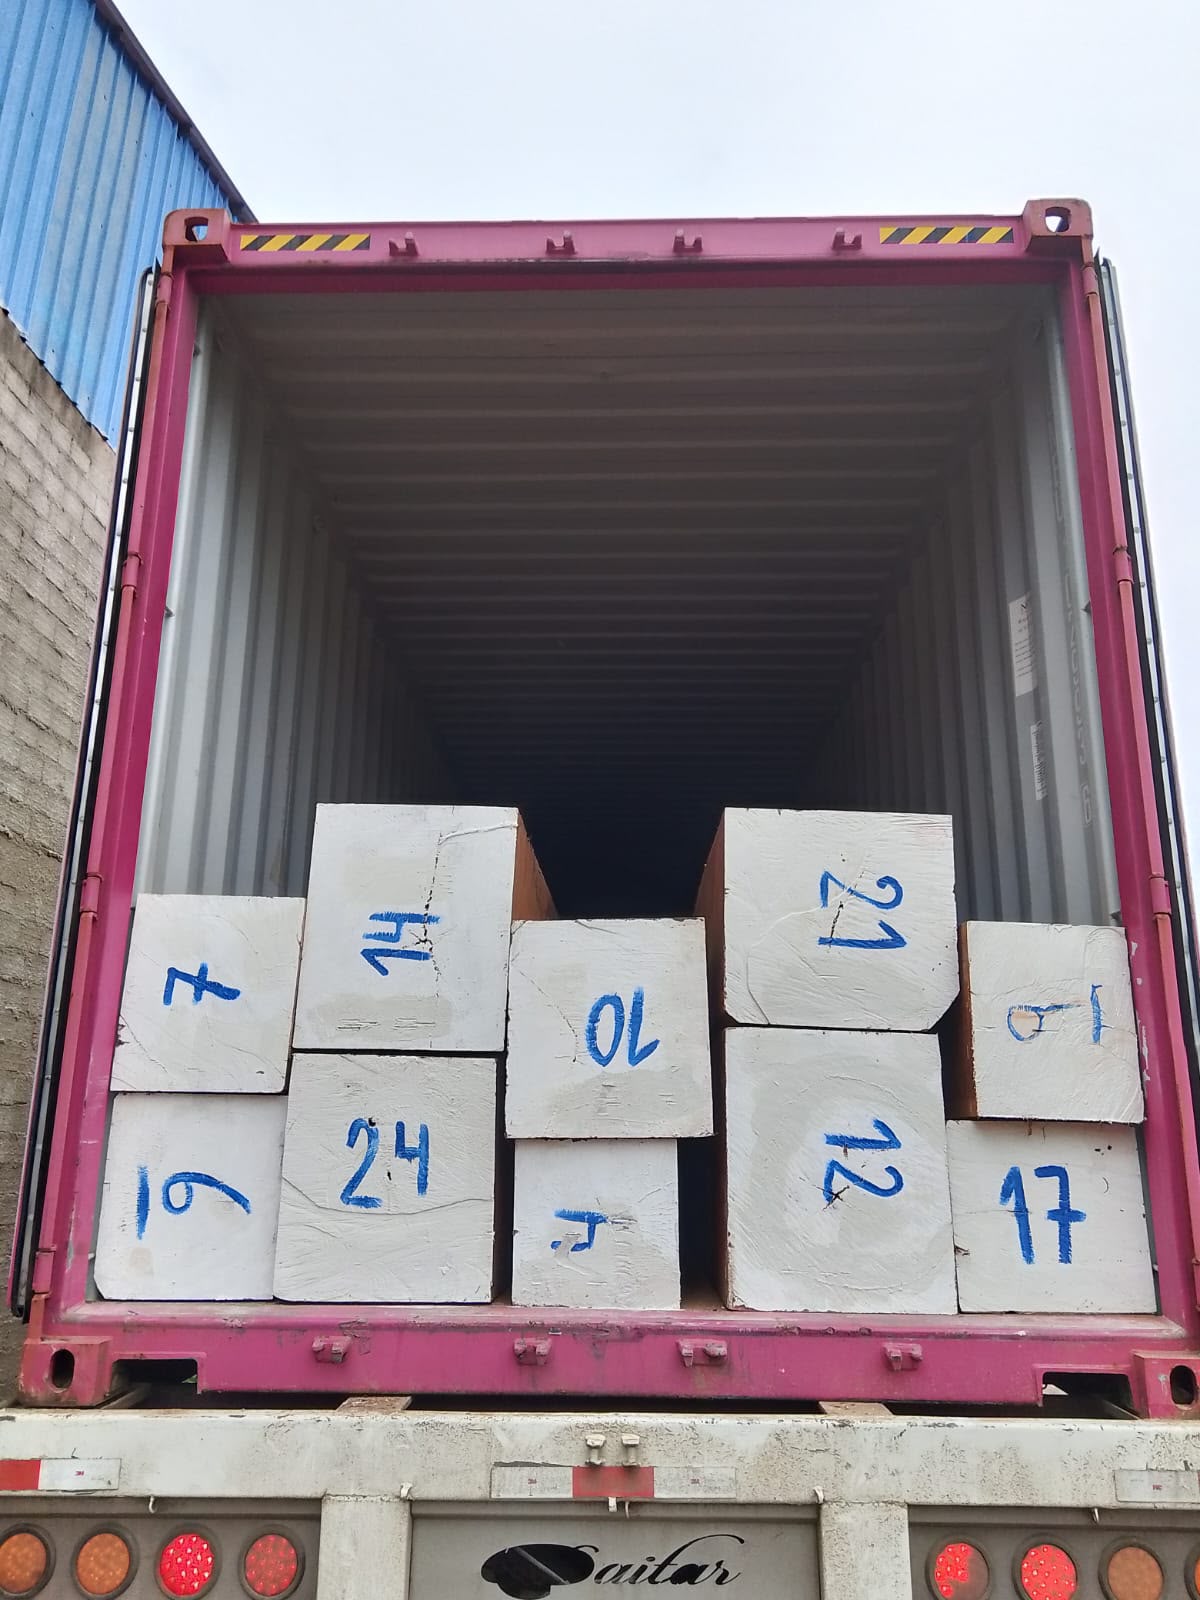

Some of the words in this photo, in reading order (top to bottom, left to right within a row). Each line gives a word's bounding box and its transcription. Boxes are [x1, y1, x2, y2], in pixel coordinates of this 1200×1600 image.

[361, 912, 440, 976] 14
[818, 870, 907, 949] 21
[163, 963, 240, 1006] 7
[585, 986, 660, 1067] 10
[340, 1118, 429, 1208] 24
[823, 1119, 904, 1204] 12
[1000, 1165, 1086, 1265] 17
